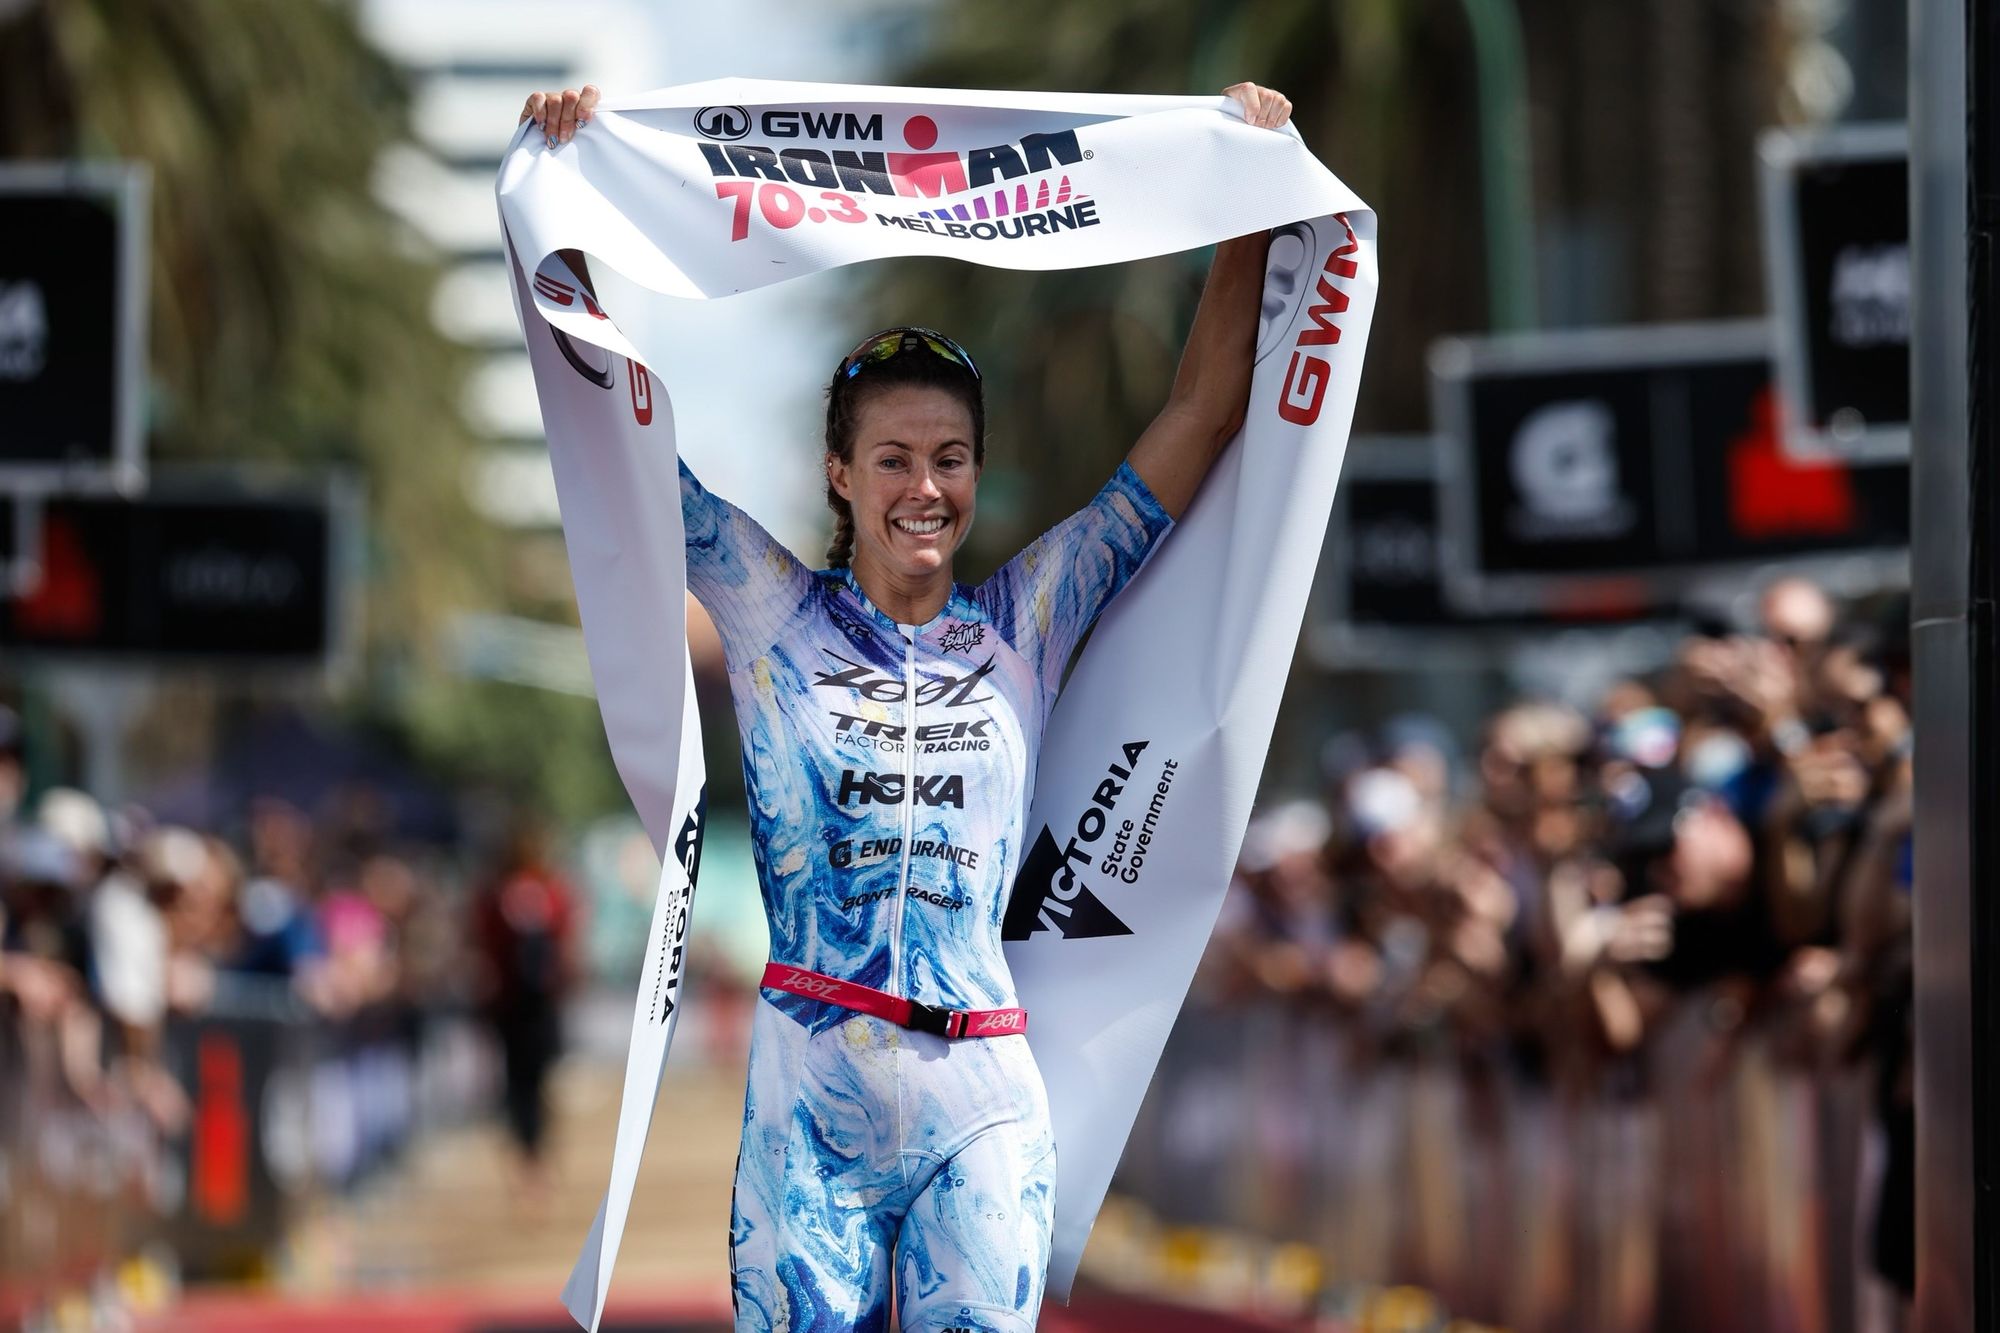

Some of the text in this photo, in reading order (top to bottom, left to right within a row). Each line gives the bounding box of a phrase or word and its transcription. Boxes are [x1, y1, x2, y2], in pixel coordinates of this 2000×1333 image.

[761, 111, 883, 141] GWM
[697, 128, 1084, 198] IRONMAN
[715, 181, 868, 242] 70.3
[876, 199, 1101, 241] MELBOURNE
[944, 624, 980, 647] BAM!
[829, 711, 994, 742] TREK
[923, 739, 991, 754] RACING
[837, 770, 964, 809] HOKA
[1028, 741, 1150, 940] VICTORIA
[1120, 758, 1179, 884] Government
[859, 838, 980, 870] ENDURANCE
[1101, 819, 1135, 878] State
[840, 887, 964, 912] BONTRAGER
